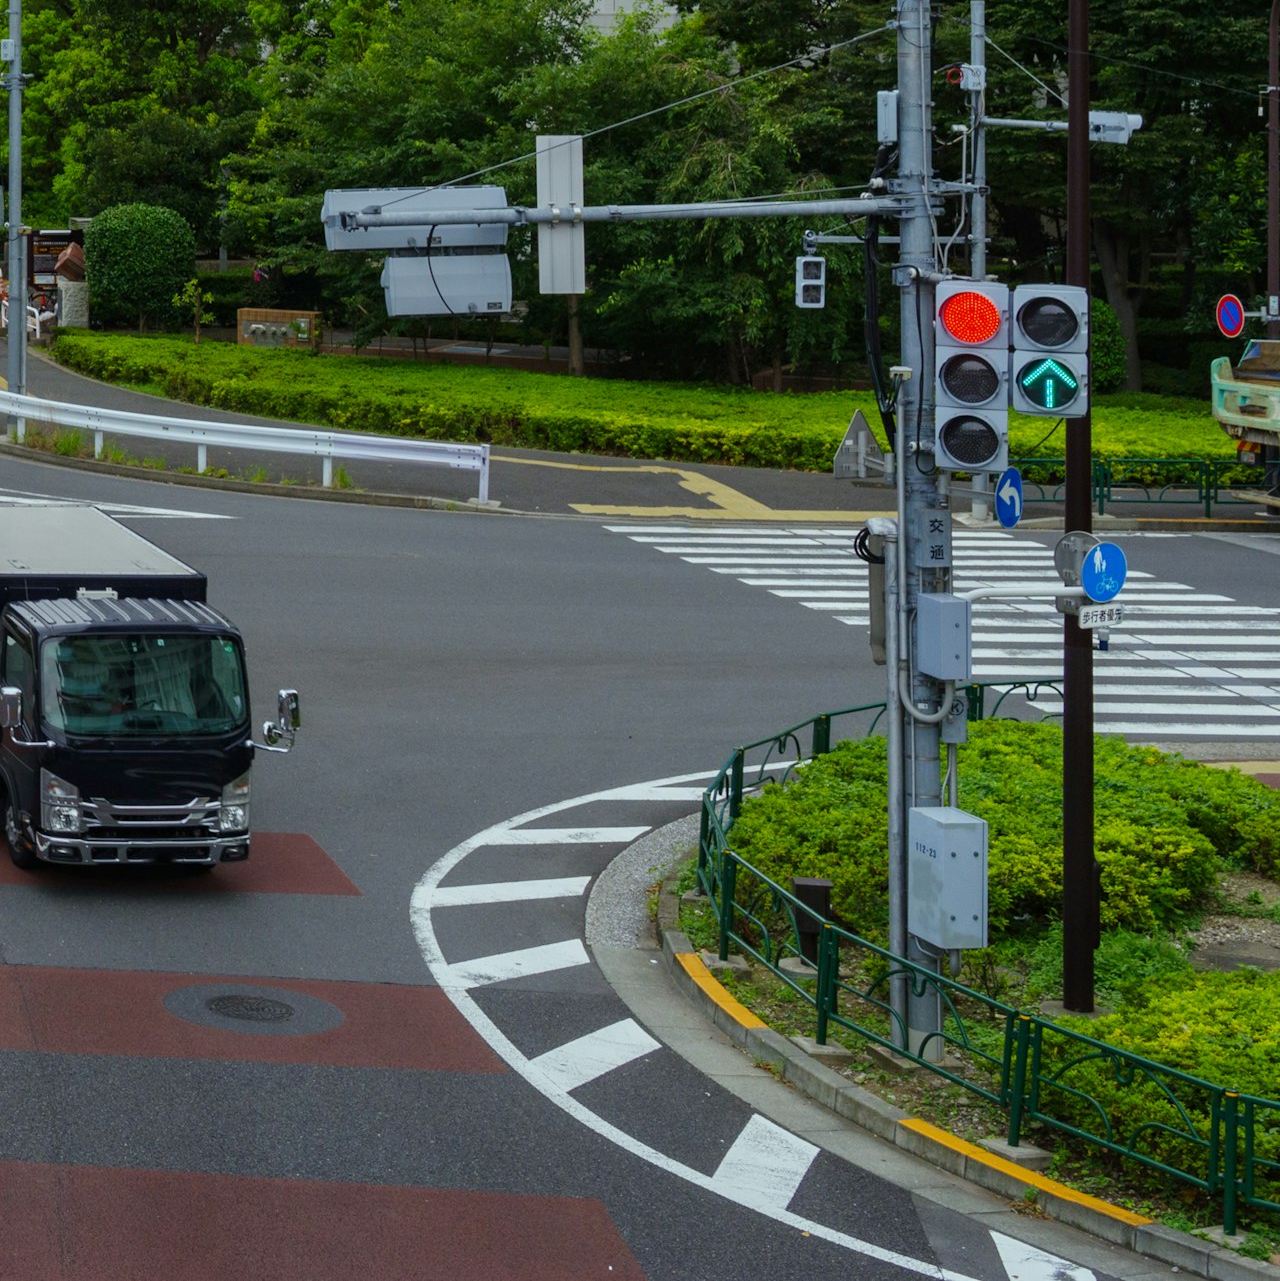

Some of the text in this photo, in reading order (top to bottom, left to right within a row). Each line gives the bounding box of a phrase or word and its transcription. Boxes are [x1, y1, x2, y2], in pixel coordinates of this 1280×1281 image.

[929, 519, 945, 560] 交通
[1082, 607, 1123, 624] 歩行者優先
